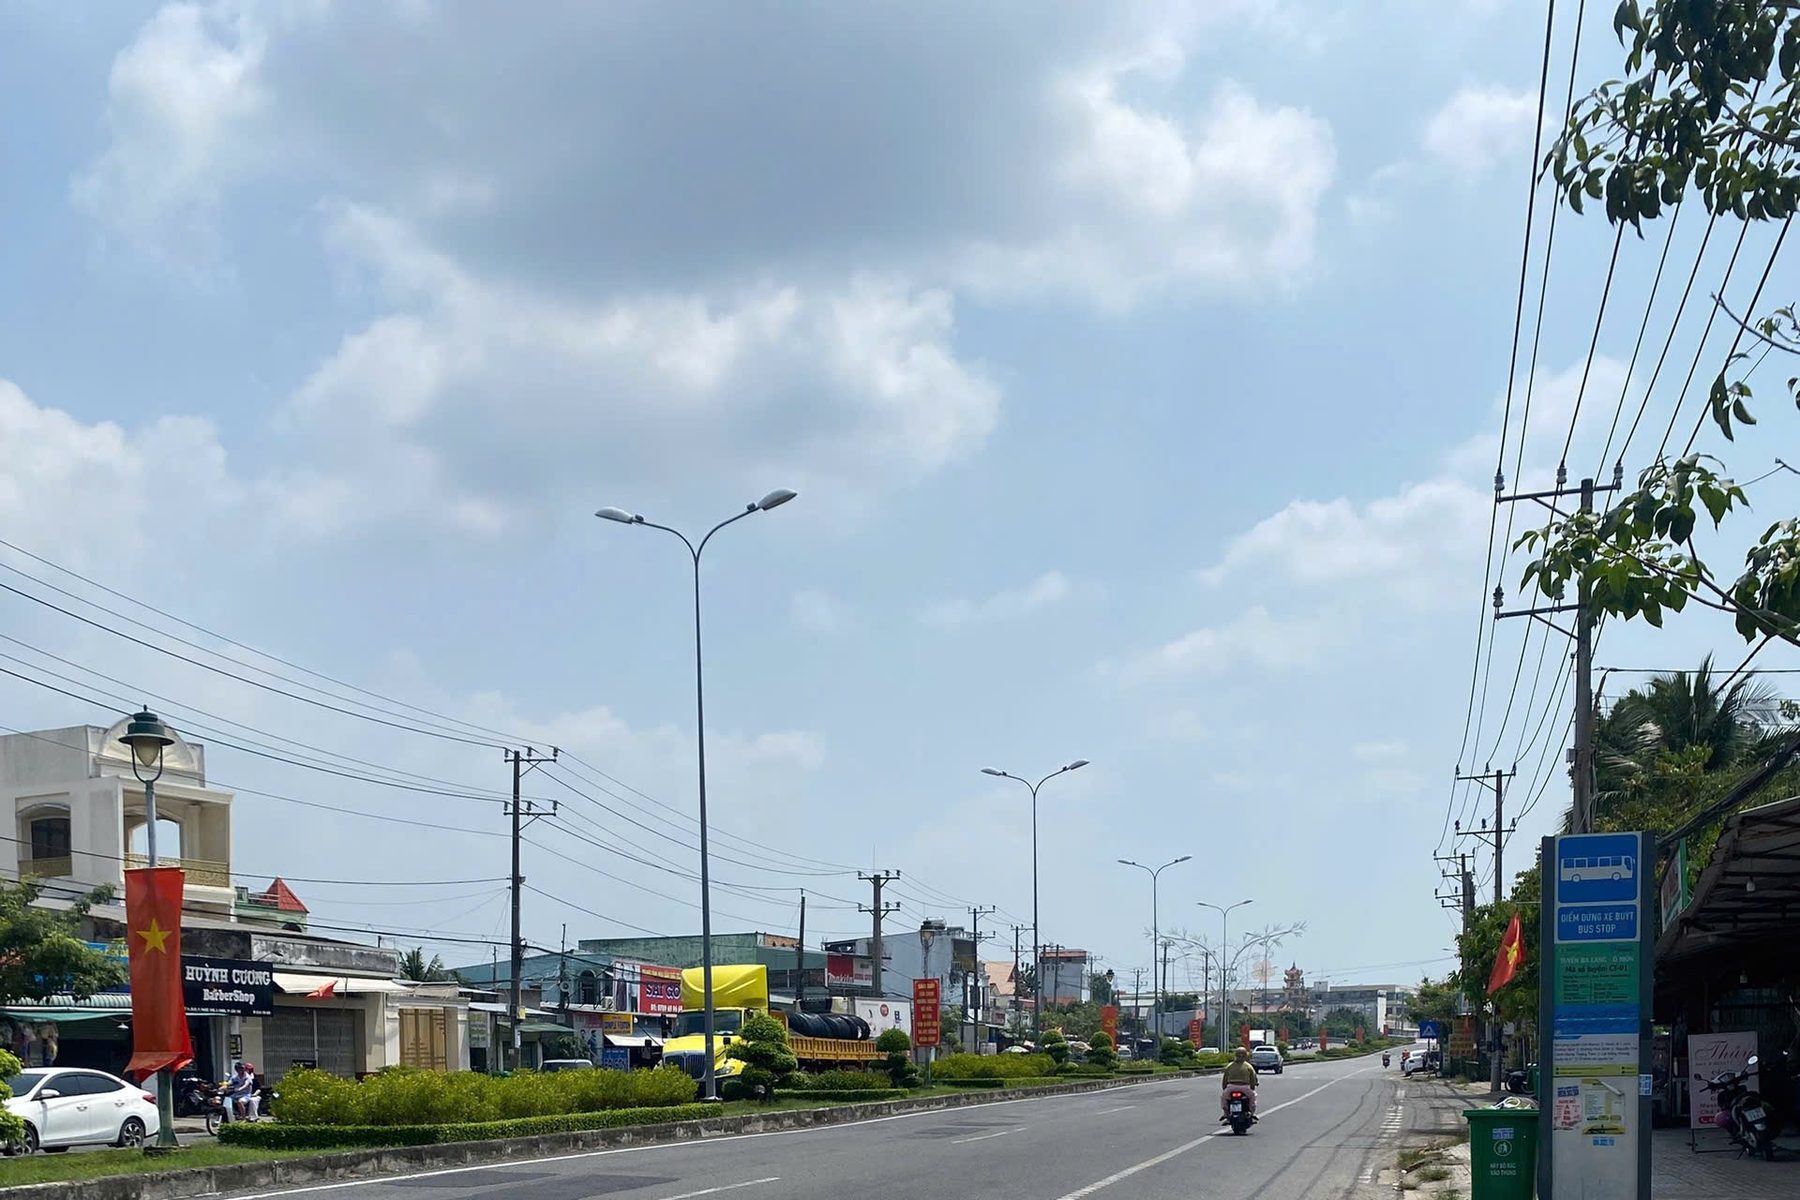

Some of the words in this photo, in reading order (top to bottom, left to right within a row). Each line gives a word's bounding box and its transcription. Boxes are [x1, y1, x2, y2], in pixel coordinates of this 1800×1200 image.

[1603, 912, 1614, 921] XE
[1578, 924, 1594, 934] BUS
[1595, 923, 1616, 933] STOP
[185, 963, 228, 983] HUỲNH
